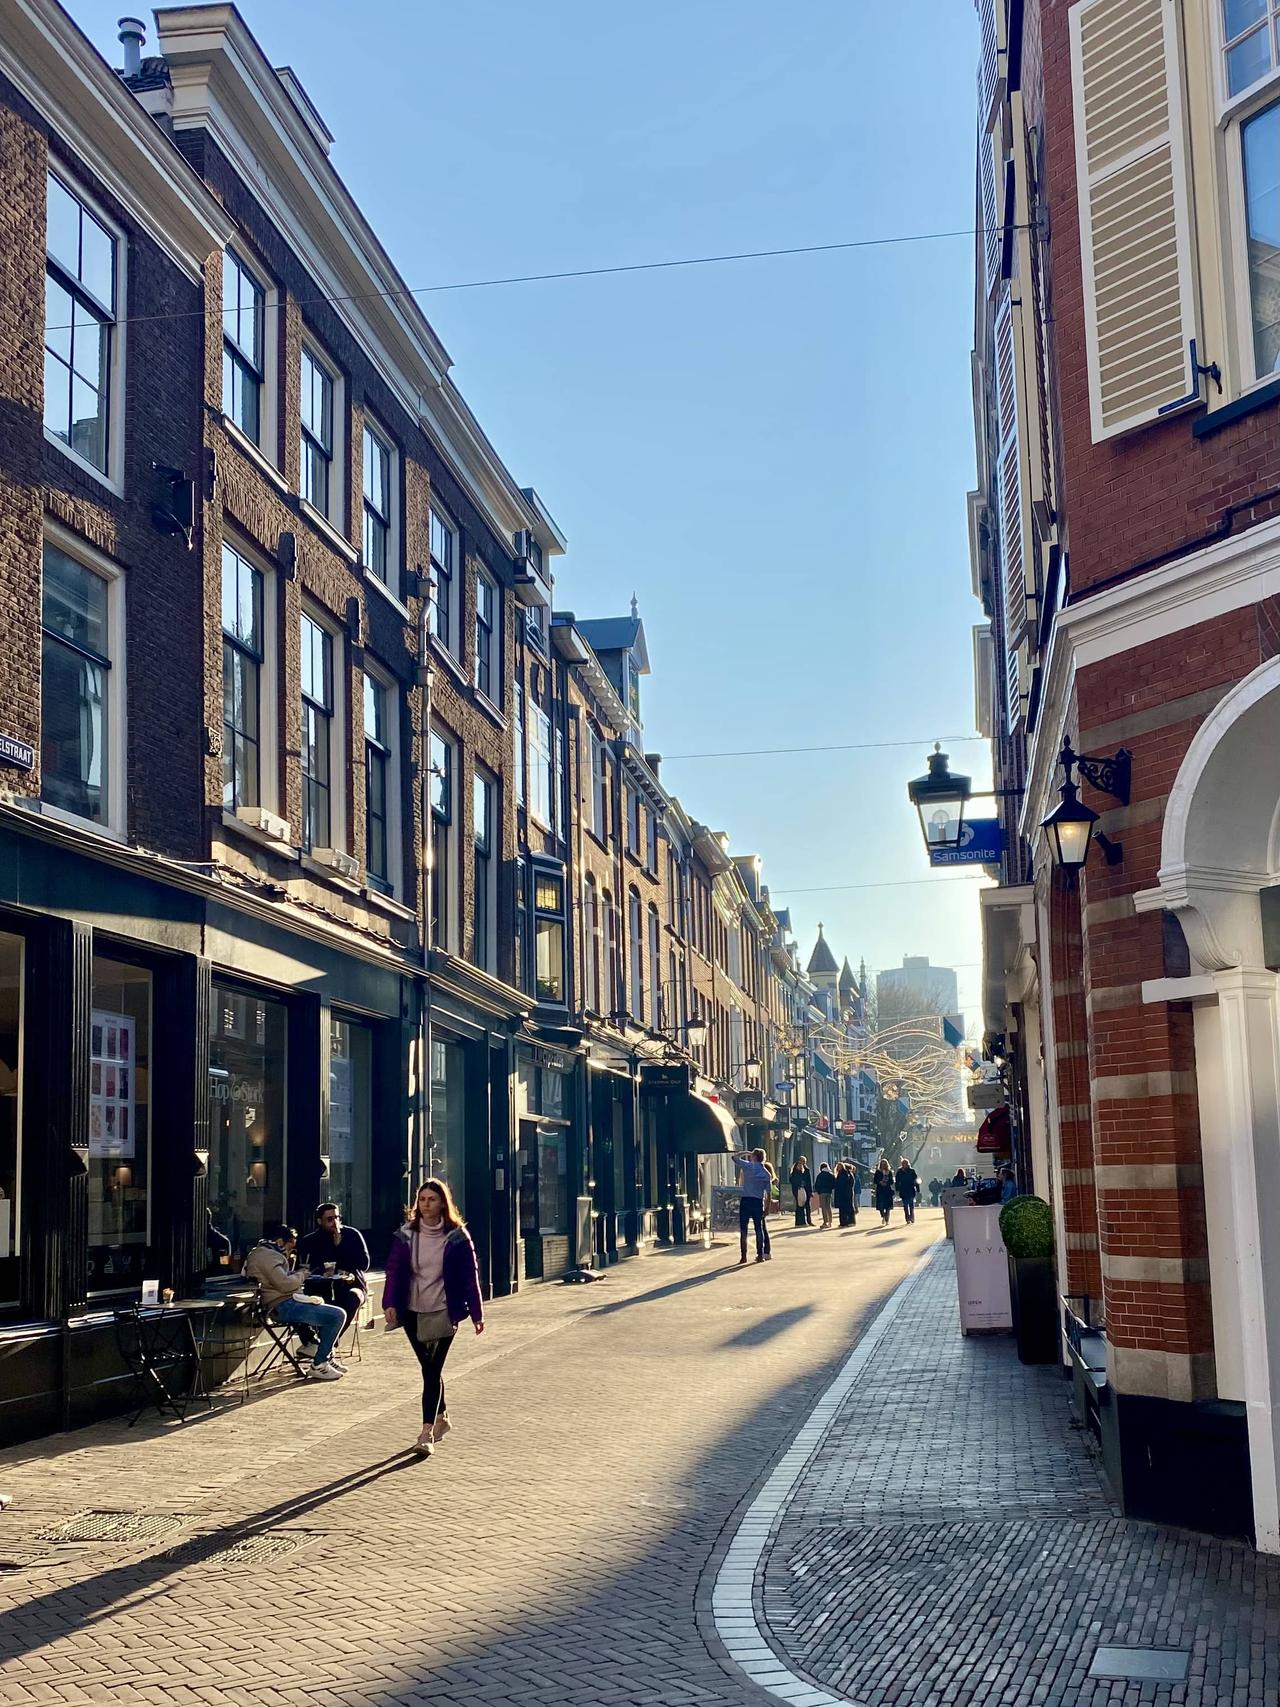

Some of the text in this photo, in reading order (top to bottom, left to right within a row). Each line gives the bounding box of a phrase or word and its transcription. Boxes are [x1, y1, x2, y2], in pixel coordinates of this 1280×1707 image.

[933, 848, 996, 862] Samsonite
[209, 1077, 230, 1105] Hop
[964, 1246, 1004, 1255] YAYA
